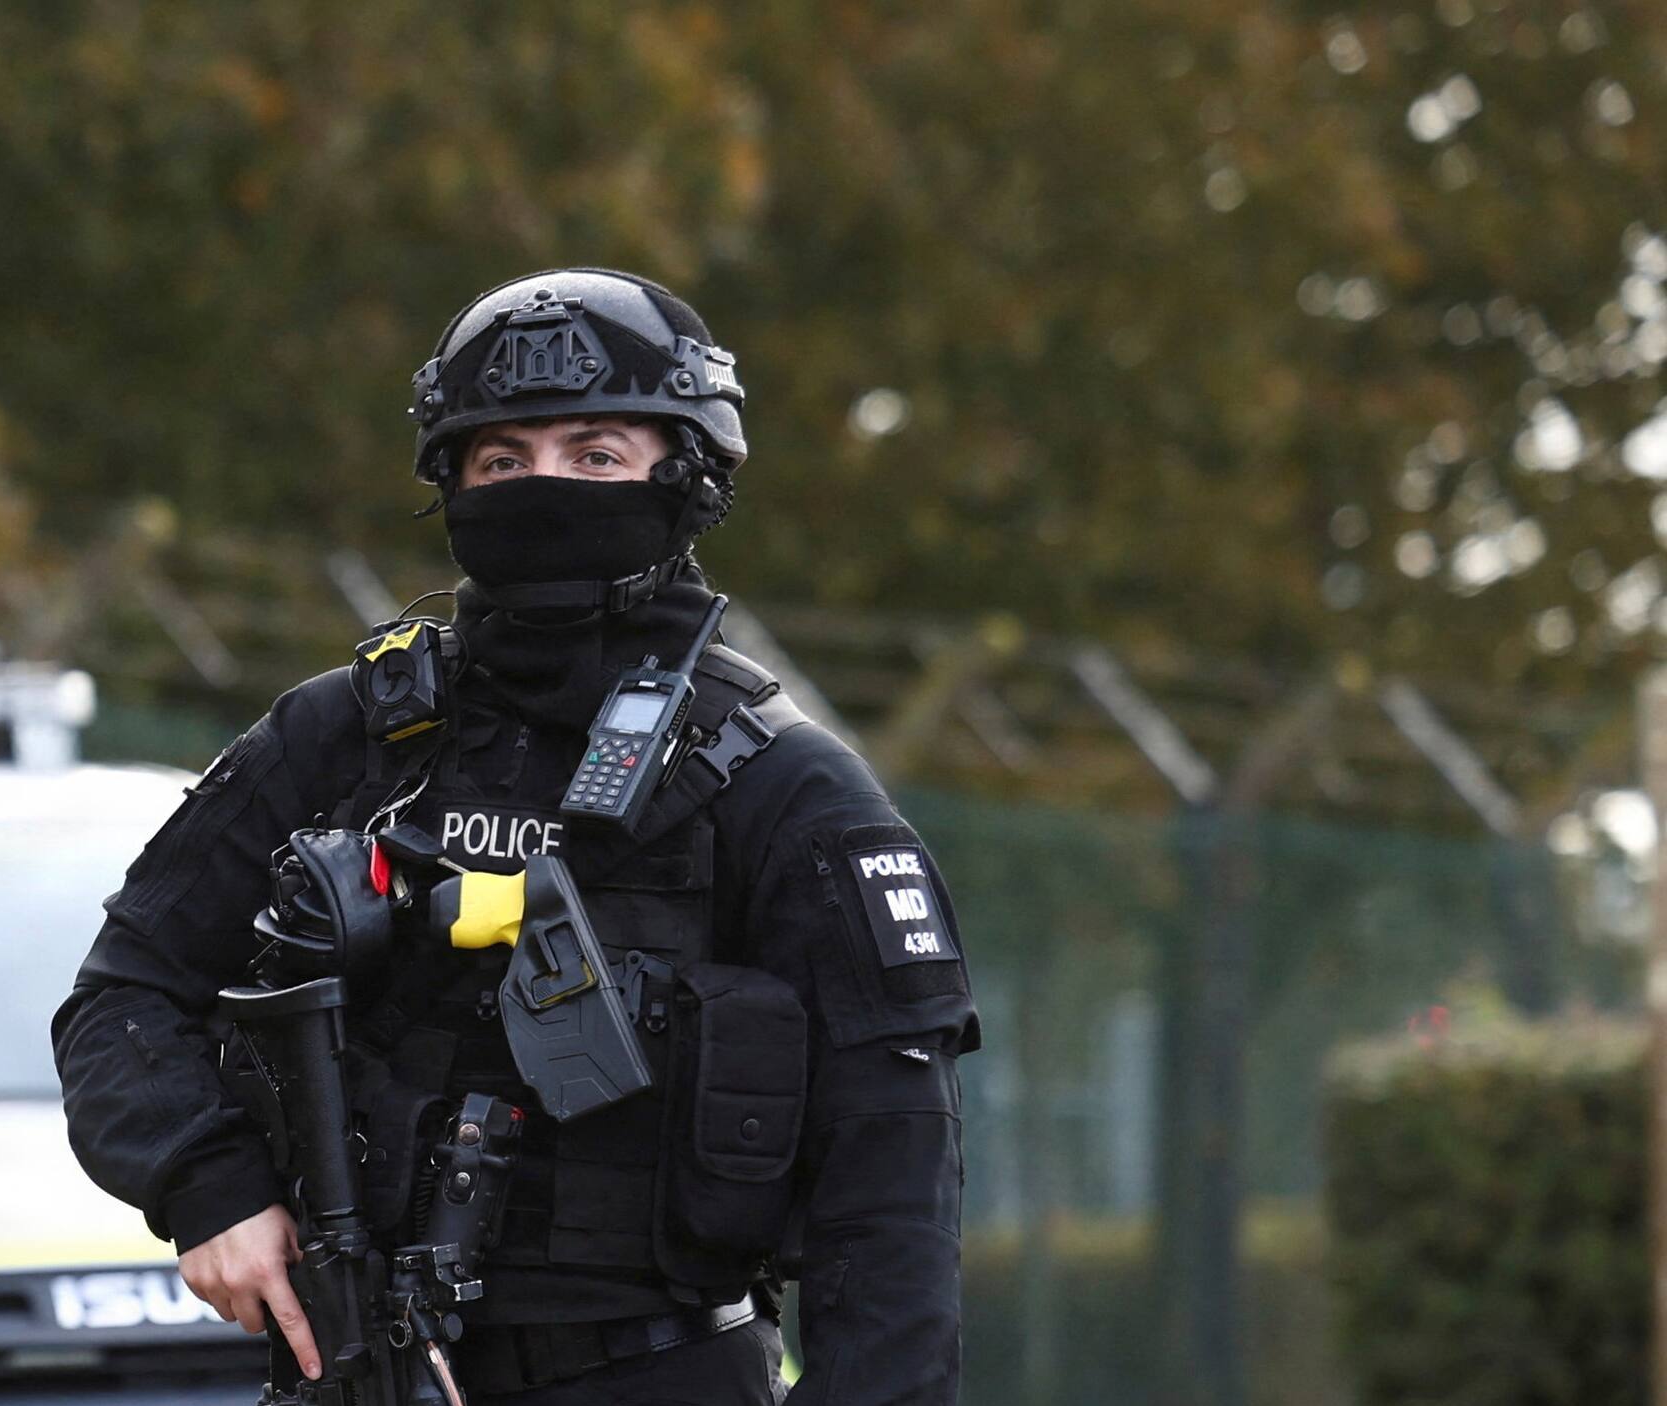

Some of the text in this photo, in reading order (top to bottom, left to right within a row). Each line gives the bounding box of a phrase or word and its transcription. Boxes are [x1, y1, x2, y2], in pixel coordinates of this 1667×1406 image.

[442, 812, 563, 861] POLICE
[859, 853, 925, 878] POLICE
[884, 888, 928, 921] MD
[51, 1270, 229, 1330] ISU
